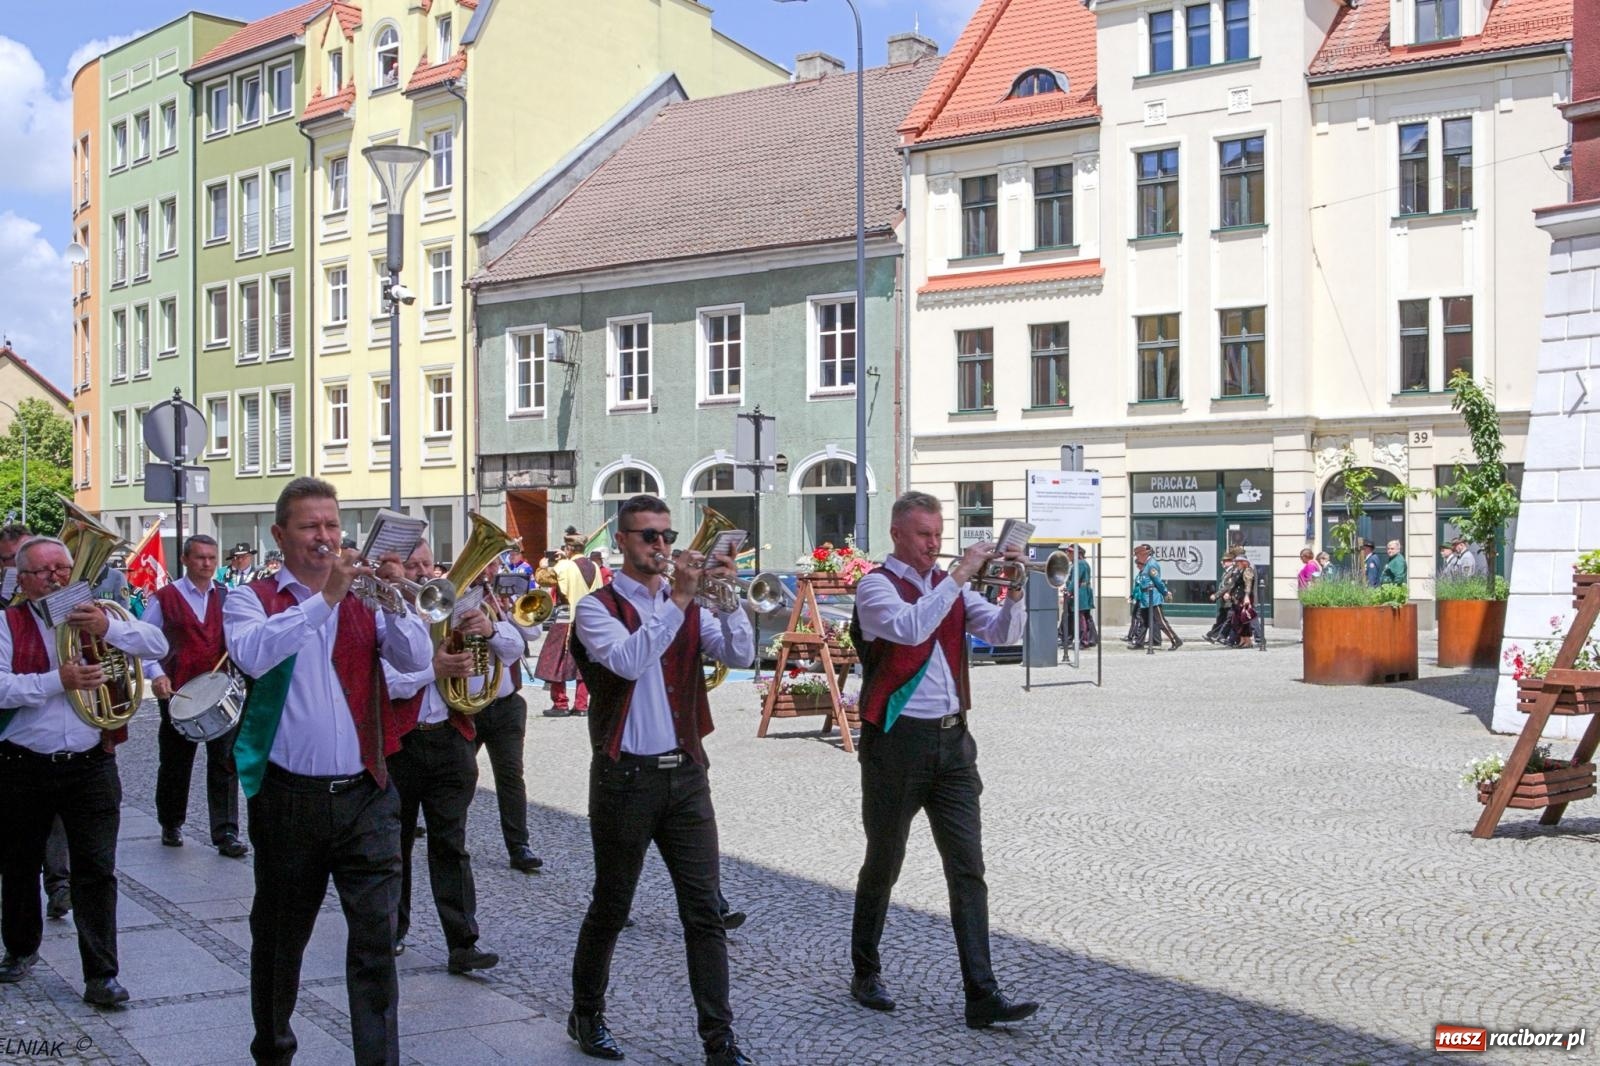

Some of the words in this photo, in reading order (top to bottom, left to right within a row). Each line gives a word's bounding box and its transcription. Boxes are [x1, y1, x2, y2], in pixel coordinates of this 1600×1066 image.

[1414, 432, 1428, 443] 39
[1151, 476, 1183, 490] PRACA
[1185, 476, 1198, 490] ZA
[1152, 495, 1197, 511] GRANICĄ
[963, 529, 985, 537] BEKAM
[1155, 546, 1187, 558] EKAM
